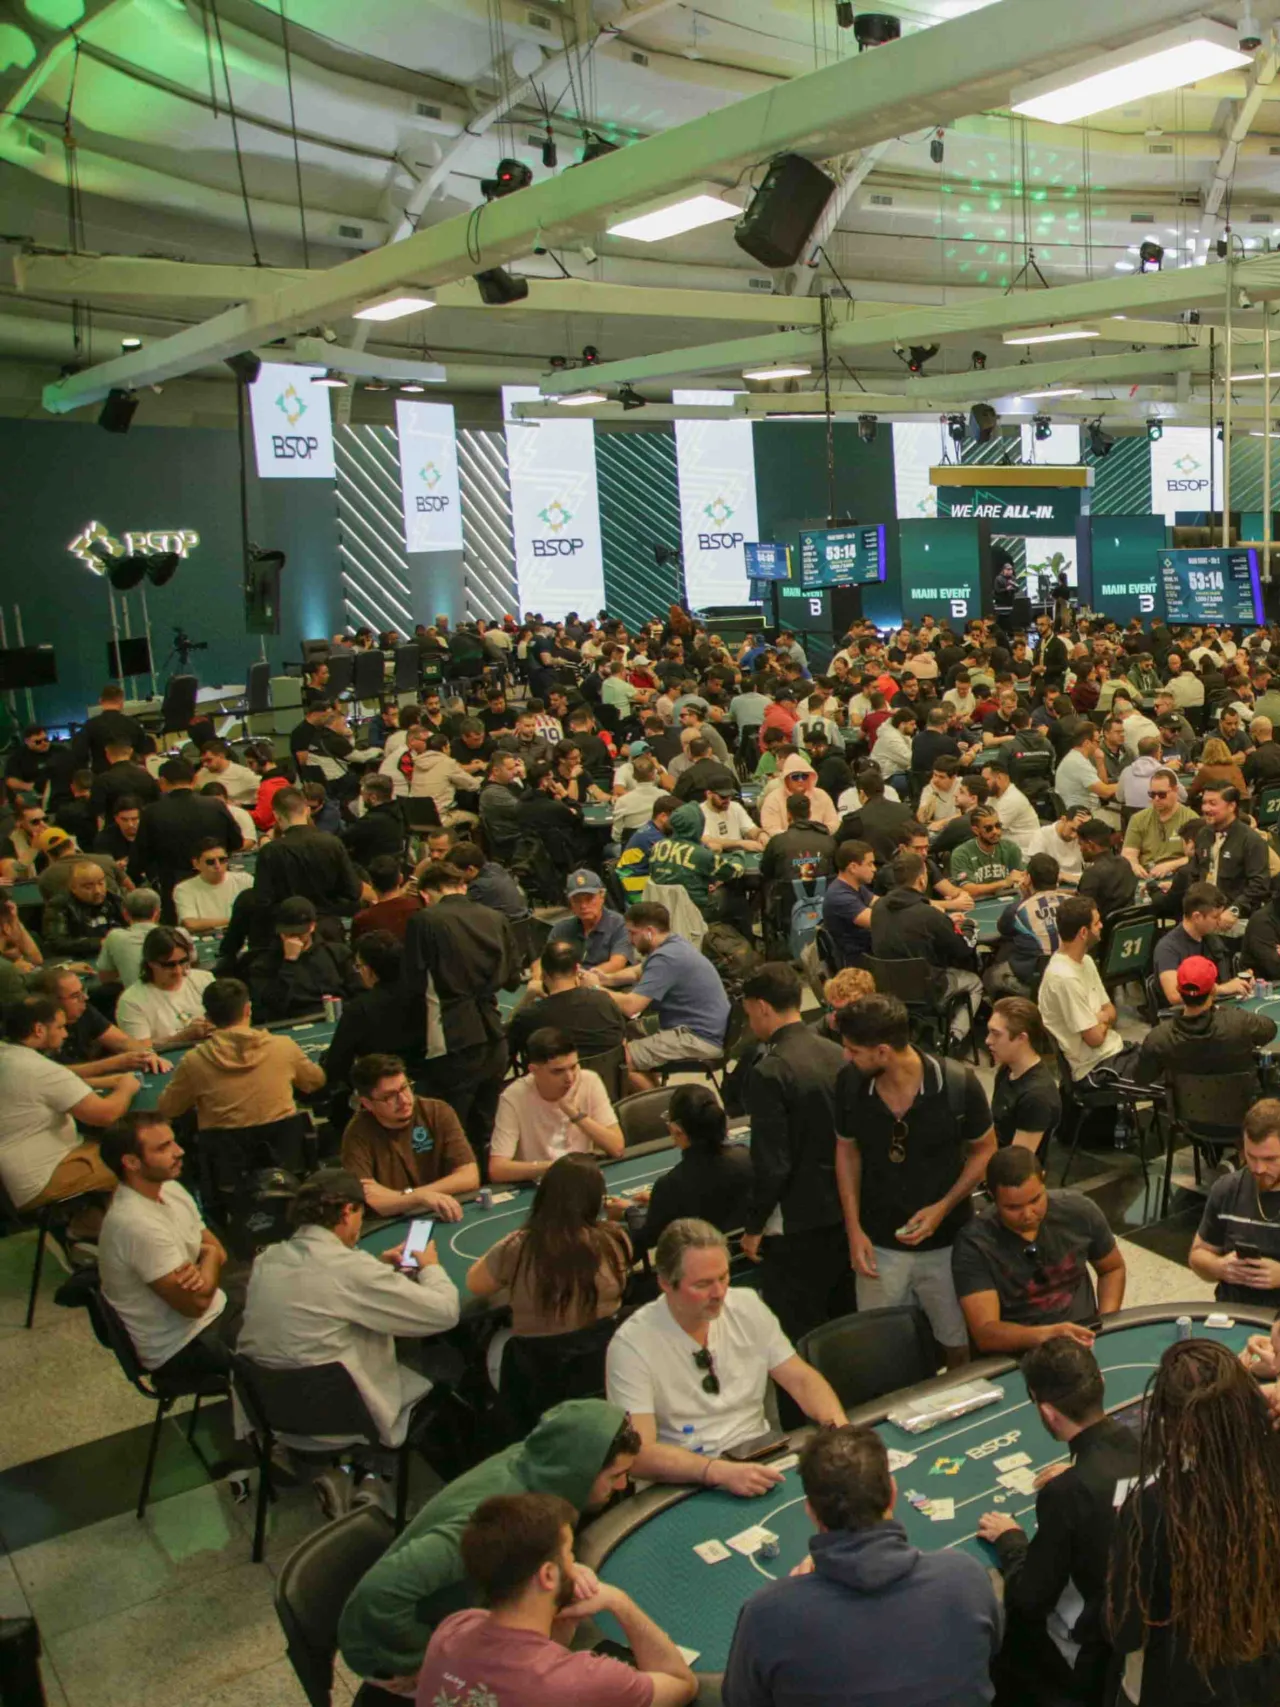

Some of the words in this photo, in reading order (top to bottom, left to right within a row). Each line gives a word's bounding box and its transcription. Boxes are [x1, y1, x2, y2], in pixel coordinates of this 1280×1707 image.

[271, 434, 319, 460] BSOP
[1166, 478, 1209, 492] BSOP
[416, 495, 450, 513] BSOP
[950, 504, 973, 518] WE
[974, 504, 1001, 518] ARE
[532, 538, 584, 557] BSOP
[698, 531, 744, 551] BSOP
[825, 543, 857, 561] 53:14
[1101, 583, 1127, 595] MAIN
[1128, 582, 1158, 594] EVENT
[1187, 571, 1225, 591] 53:14
[911, 588, 938, 599] MAIN
[939, 587, 971, 599] EVENT
[538, 727, 561, 746] 19
[1121, 936, 1143, 958] 31
[965, 1429, 1022, 1460] BSOP
